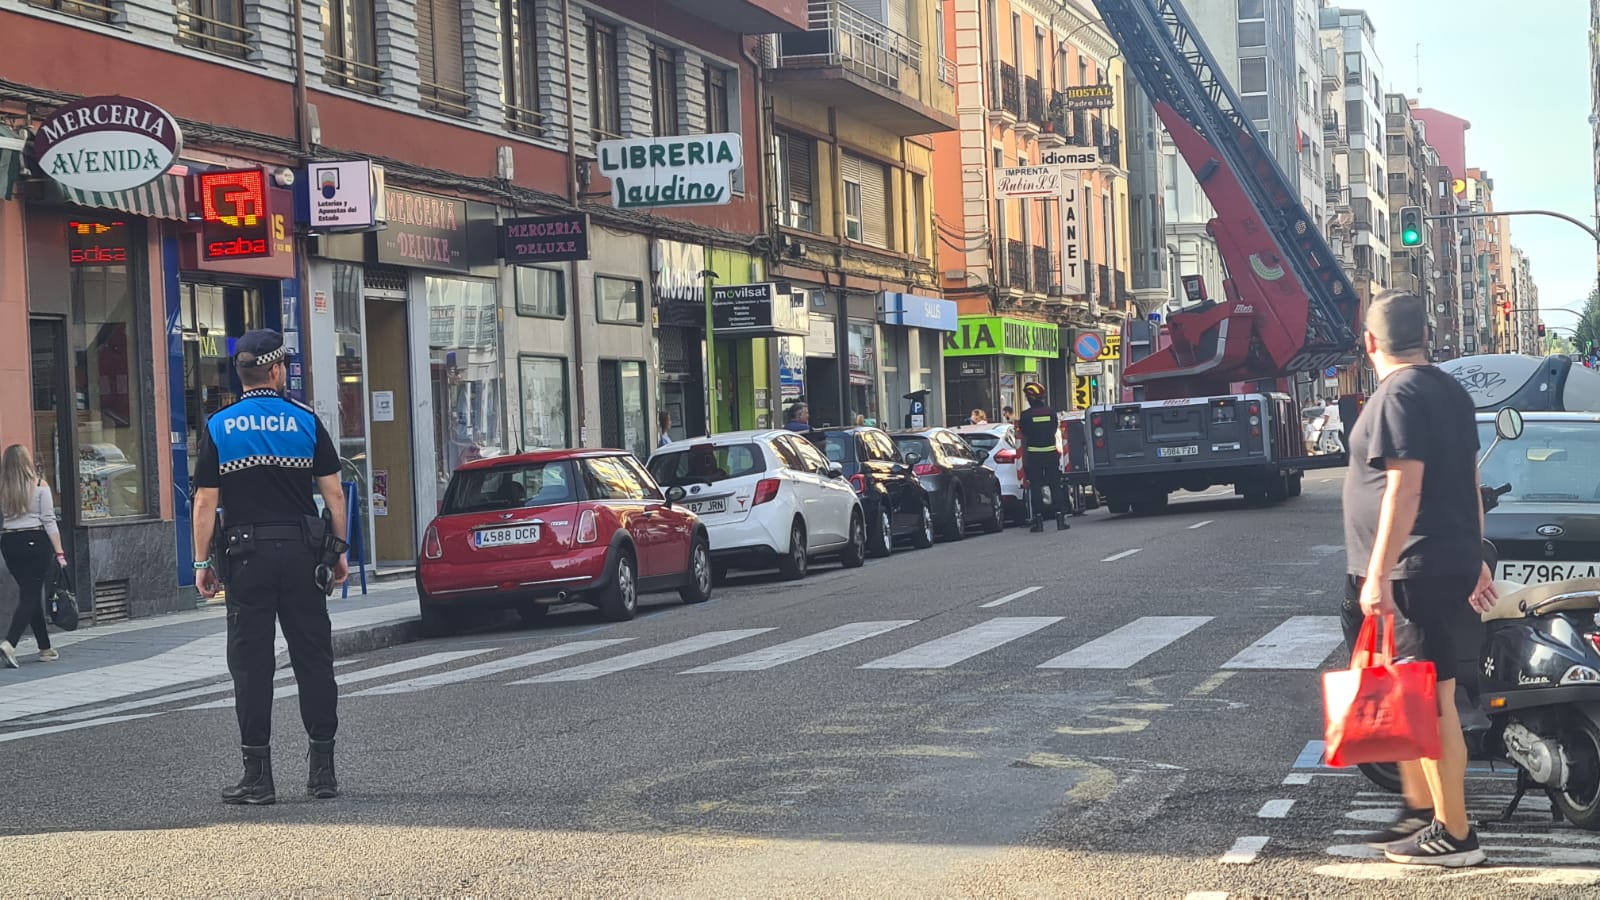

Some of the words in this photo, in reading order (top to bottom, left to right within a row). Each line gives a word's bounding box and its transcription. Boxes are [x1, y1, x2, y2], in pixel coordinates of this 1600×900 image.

[1068, 87, 1111, 98] HOSTAL
[1069, 100, 1093, 108] Padre
[1096, 98, 1111, 106] Isla
[41, 104, 165, 144] MERCERIA
[51, 148, 161, 175] AVENIDA
[602, 140, 733, 170] LIBRERIA
[1041, 151, 1095, 165] idiomas
[1006, 167, 1048, 176] IMPRENTA
[1066, 188, 1077, 278] JANET
[208, 237, 266, 257] saba
[397, 232, 450, 264] DELUXE
[515, 241, 576, 255] DELUXE
[914, 402, 922, 413] P
[223, 412, 299, 434] POLICÍA
[708, 500, 724, 511] JRN
[484, 530, 511, 542] 4588
[515, 528, 537, 540] DCR
